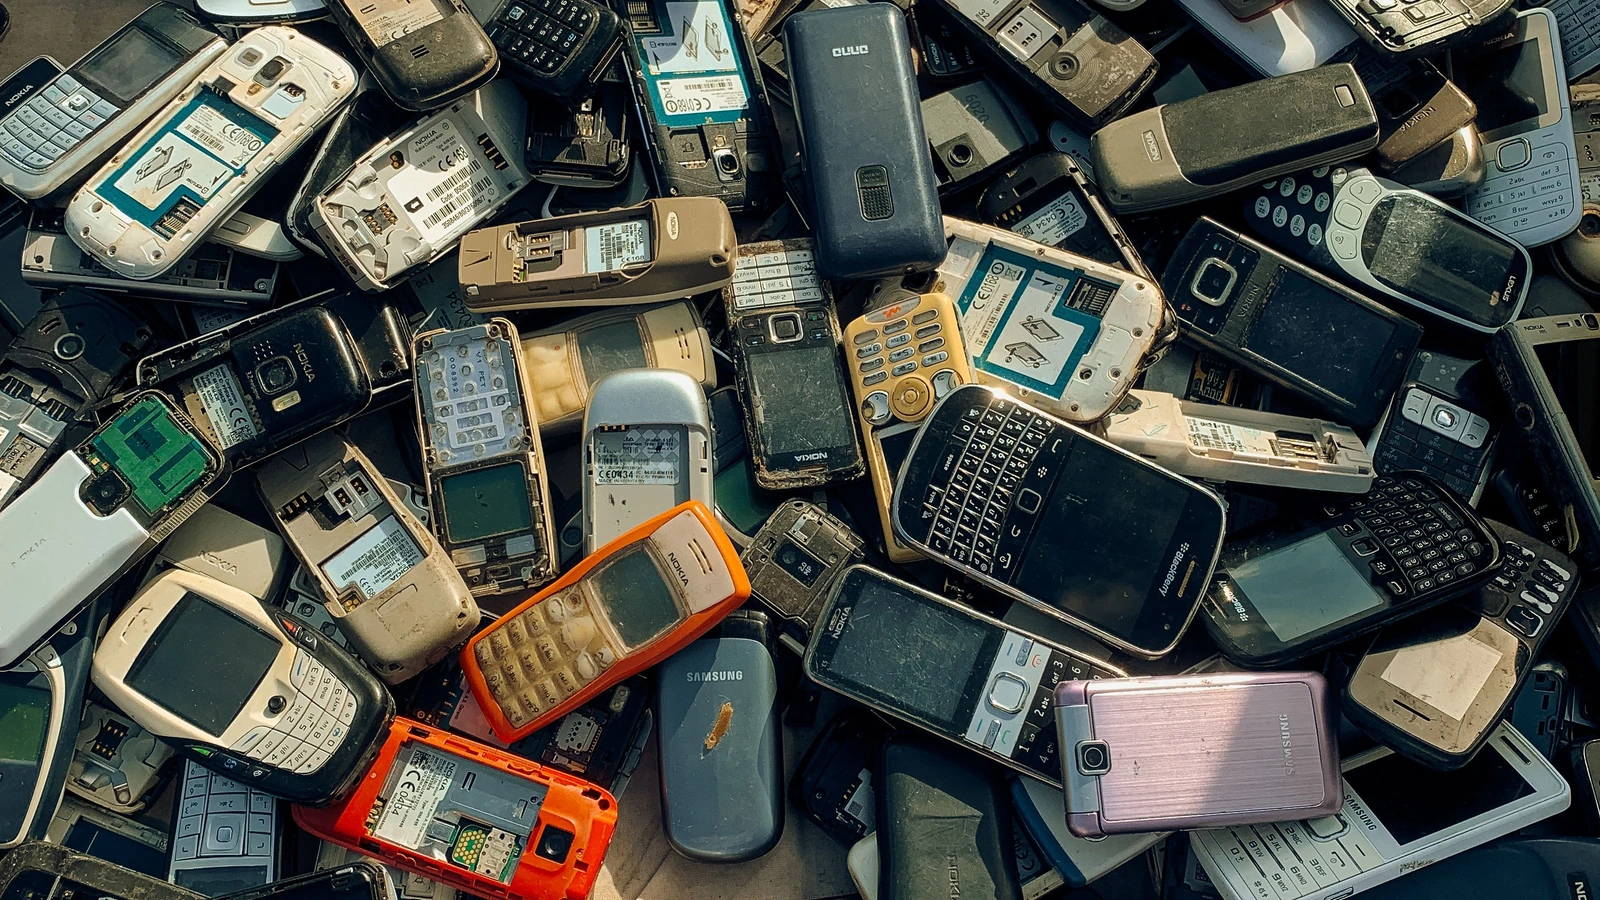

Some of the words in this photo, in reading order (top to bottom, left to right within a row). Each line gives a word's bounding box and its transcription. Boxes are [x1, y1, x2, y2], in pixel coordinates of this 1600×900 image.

[364, 15, 388, 29] NOKIA
[978, 9, 990, 20] 32
[1483, 32, 1515, 47] NOKIA
[930, 43, 940, 66] NOKIA
[5, 84, 34, 107] NOKIA
[966, 95, 990, 124] 6020
[1400, 106, 1436, 133] NOKIA
[415, 130, 437, 146] NOKIA
[1144, 131, 1160, 162] NOKIA
[1054, 223, 1080, 239] NOKIA
[1237, 285, 1259, 317] NOKIA
[293, 342, 316, 383] NOKIA
[479, 370, 487, 387] PET
[794, 452, 828, 463] NOKIA
[944, 454, 955, 471] space
[1438, 508, 1452, 522] space
[198, 550, 237, 576] NOKIA
[389, 562, 416, 581] NOKIA
[668, 552, 689, 588] NOKIA
[1159, 551, 1185, 598] BlackBerry
[831, 607, 852, 639] NOKIA
[686, 671, 743, 682] SAMSUNG
[1278, 713, 1294, 776] SAMSUNG
[439, 762, 456, 792] NOKIA
[1344, 794, 1377, 832] SAMSUNG
[1266, 834, 1275, 842] 5
[1272, 840, 1281, 852] JKL
[1285, 827, 1293, 836] 2
[1291, 834, 1303, 845] ABC
[1249, 840, 1258, 848] 8
[1254, 847, 1264, 858] TUV
[1290, 866, 1299, 874] 6
[1296, 873, 1307, 886] MNO
[1309, 858, 1318, 867] 3
[1316, 865, 1327, 878] DEF
[1272, 873, 1280, 881] 9
[1278, 880, 1289, 893] WXYZ
